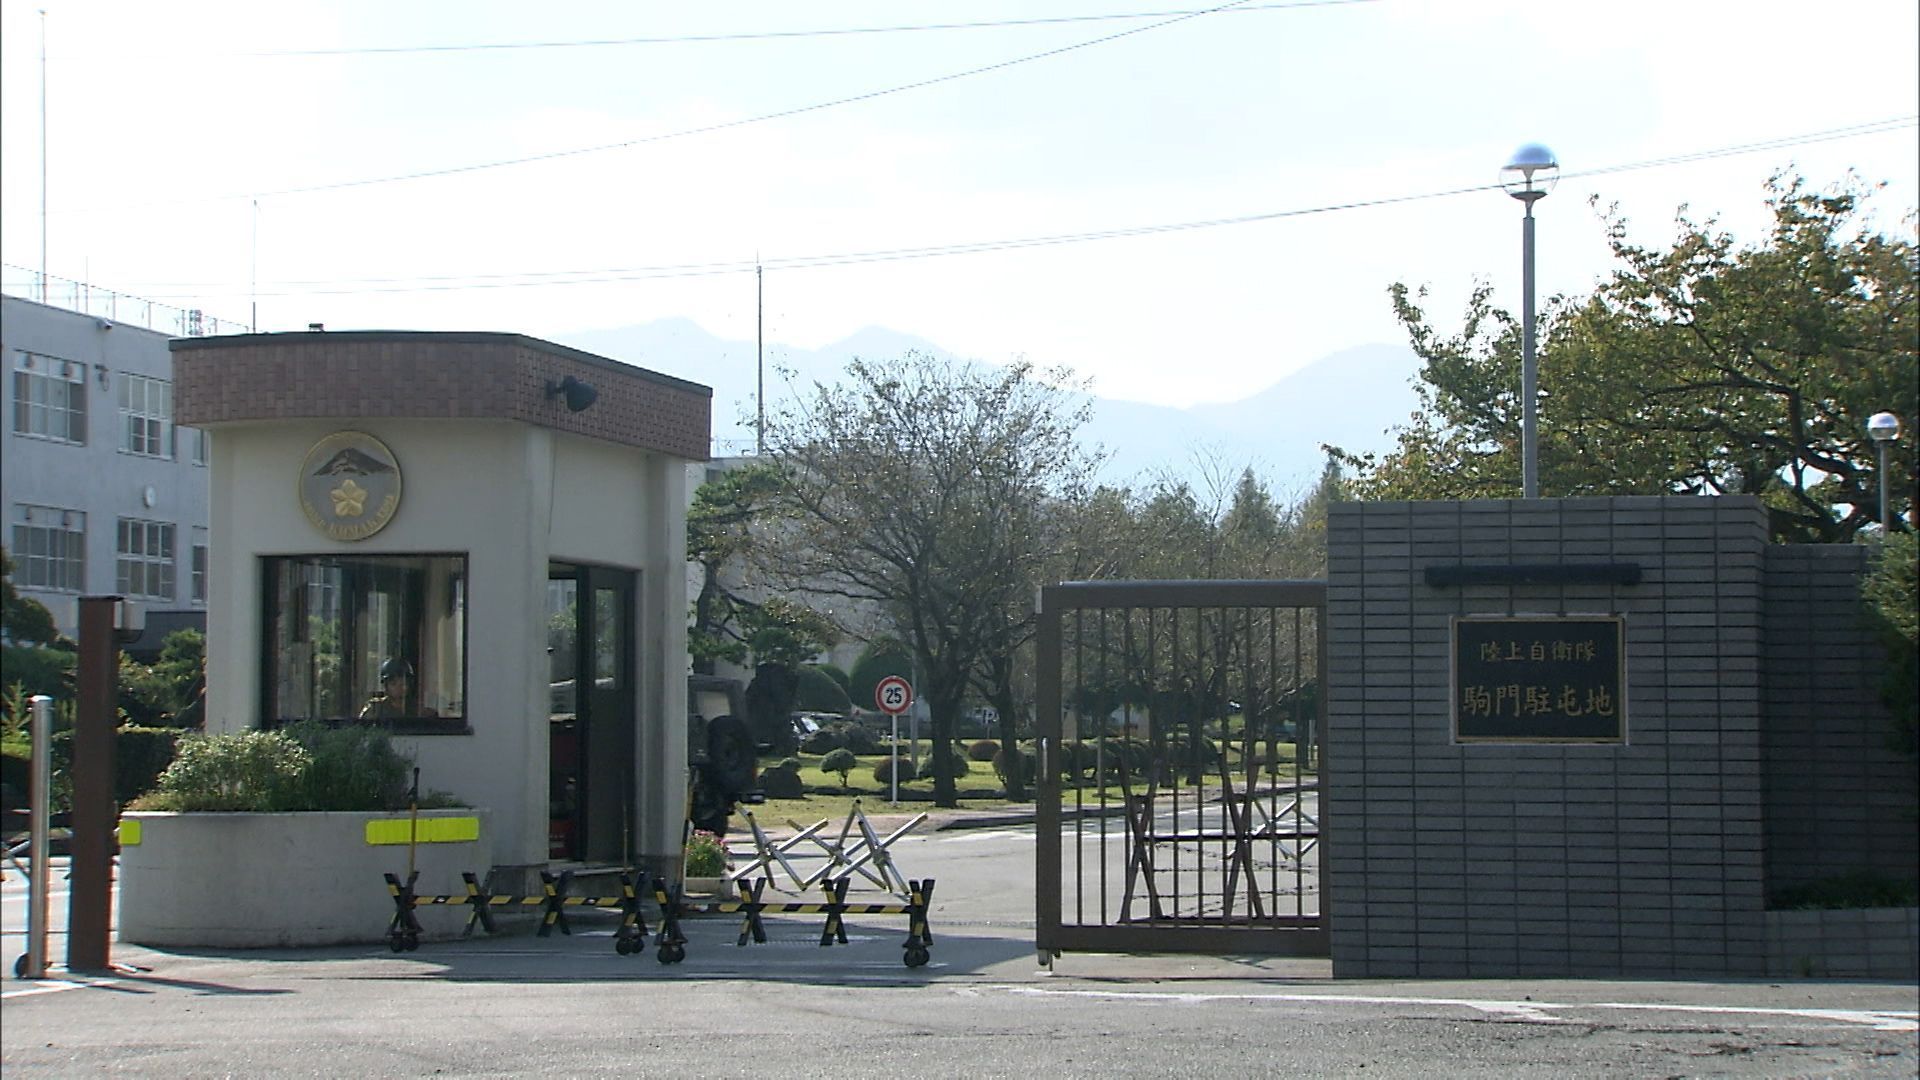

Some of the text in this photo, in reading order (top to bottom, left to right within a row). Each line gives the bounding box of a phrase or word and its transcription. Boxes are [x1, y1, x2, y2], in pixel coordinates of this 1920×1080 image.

[1480, 640, 1596, 663] 陸上自衛隊
[886, 687, 902, 704] 25
[1462, 684, 1614, 718] 駒門駐屯地
